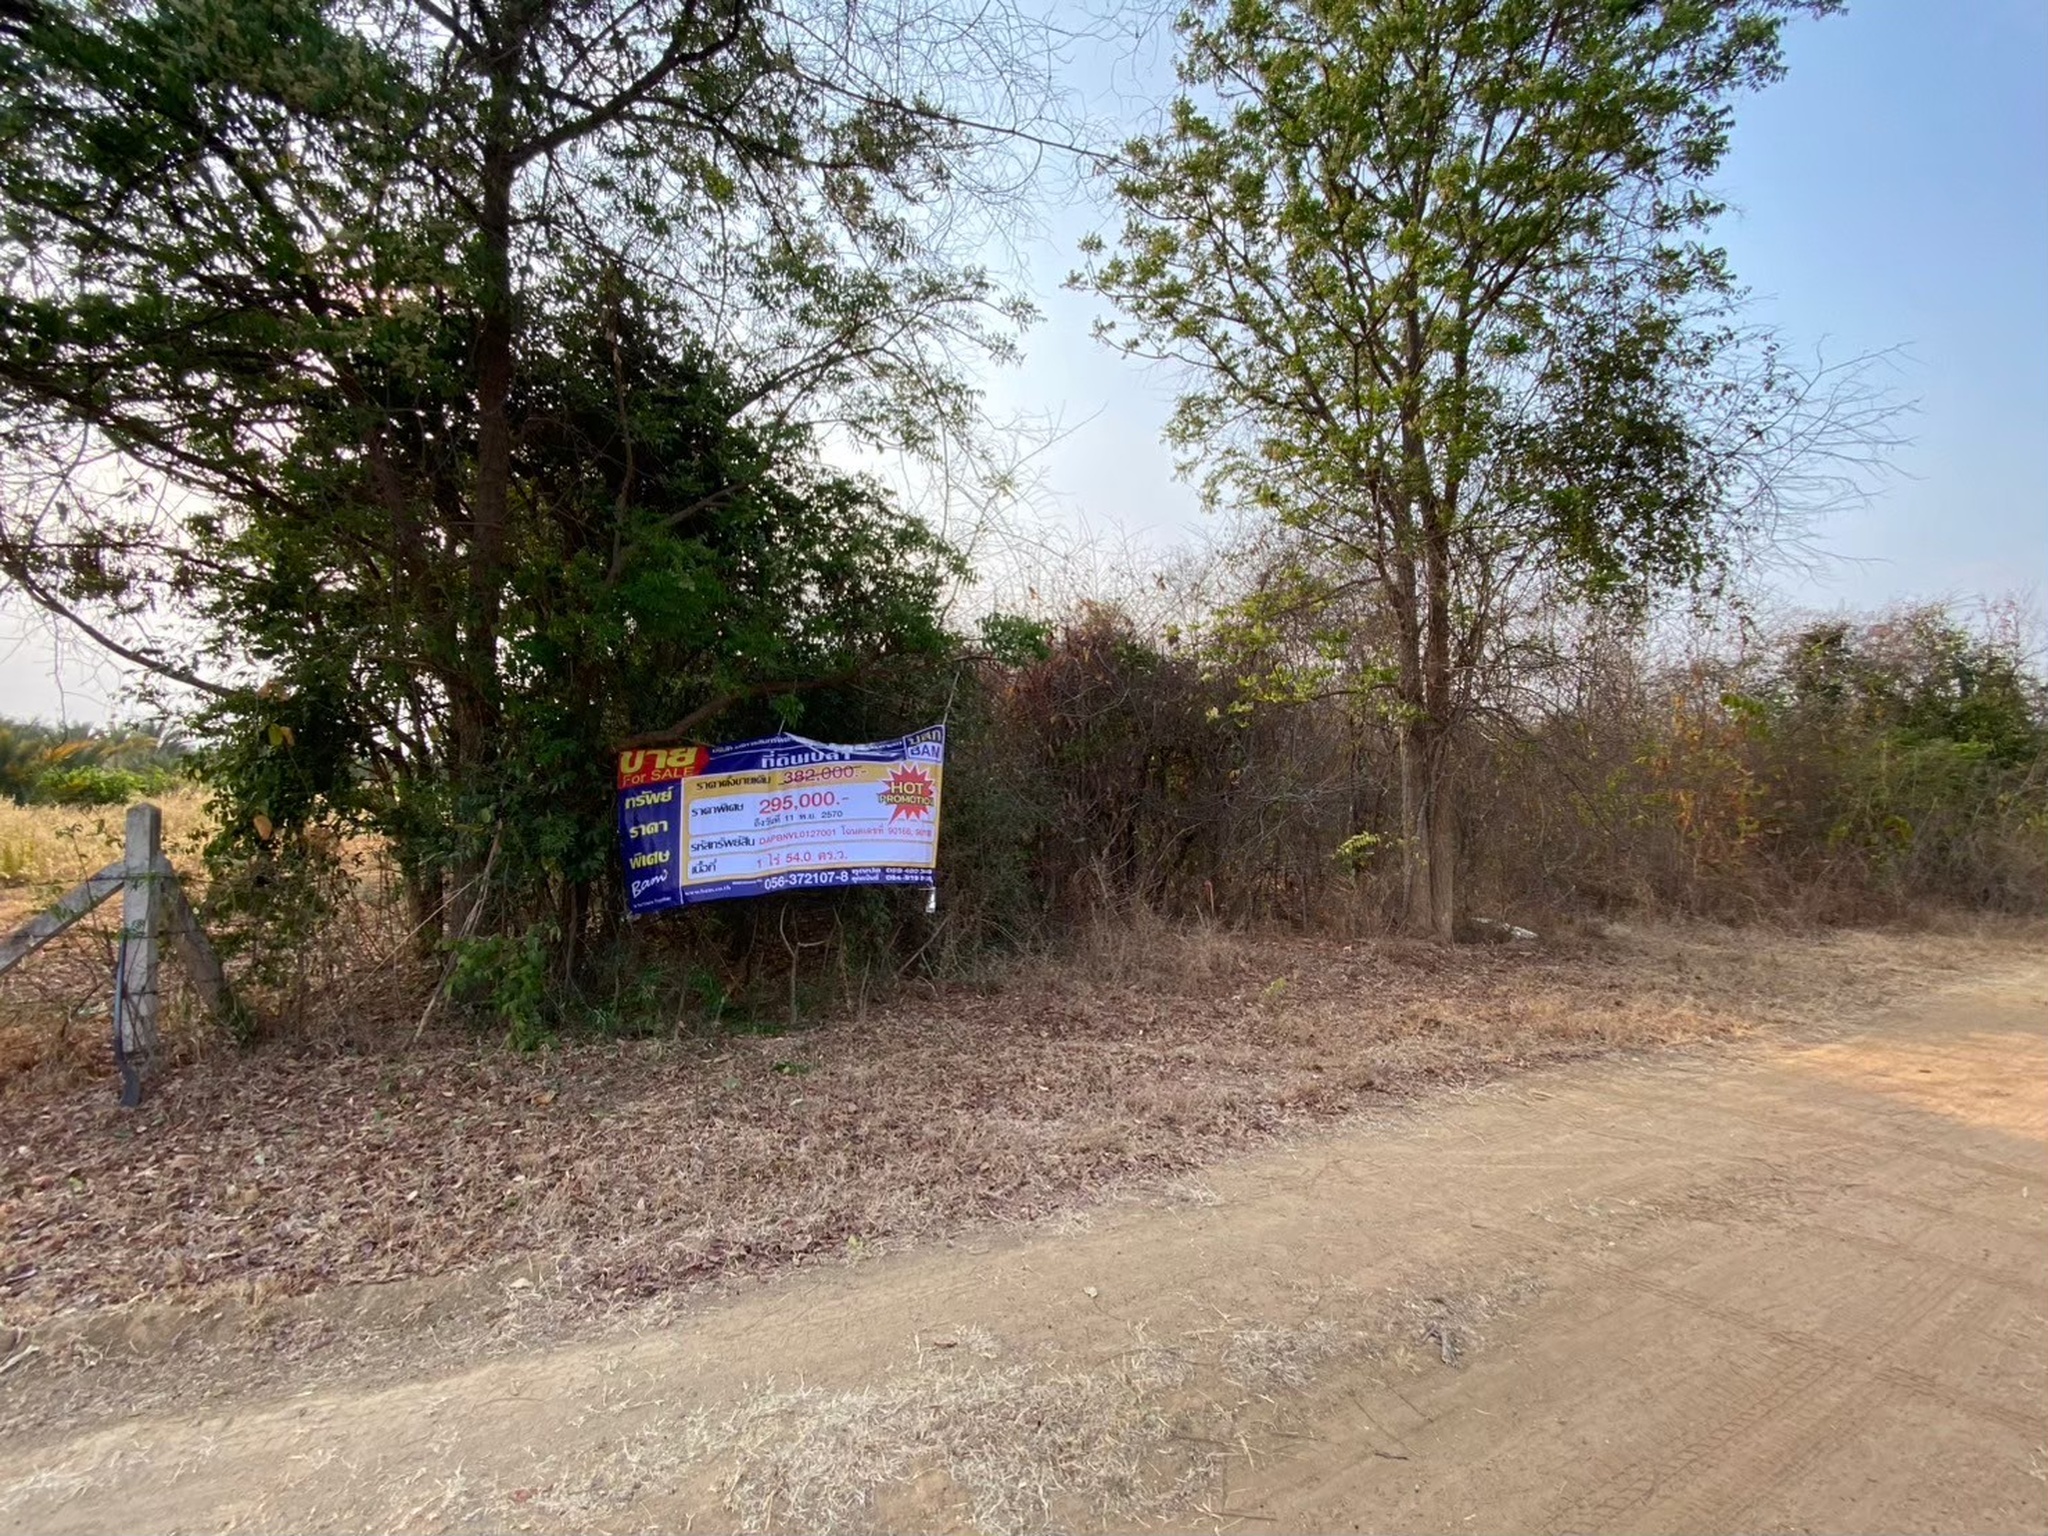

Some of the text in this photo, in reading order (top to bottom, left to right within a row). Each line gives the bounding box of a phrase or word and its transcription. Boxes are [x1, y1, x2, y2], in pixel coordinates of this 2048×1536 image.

[620, 746, 698, 774] ขาย
[622, 766, 695, 787] For SALE
[625, 786, 675, 810] ทรัพย์
[890, 781, 924, 795] HOT
[691, 803, 744, 817] ราคาพิเศษ
[785, 814, 795, 822] 11
[821, 810, 843, 819] 2570
[629, 820, 669, 839] ราคา
[691, 835, 756, 853] รหัสทรัพย์สิน
[629, 850, 671, 870] พิเศษ
[691, 857, 718, 875] เนื้อที่
[786, 851, 811, 863] 54.0
[764, 870, 849, 890] 056-372107-8
